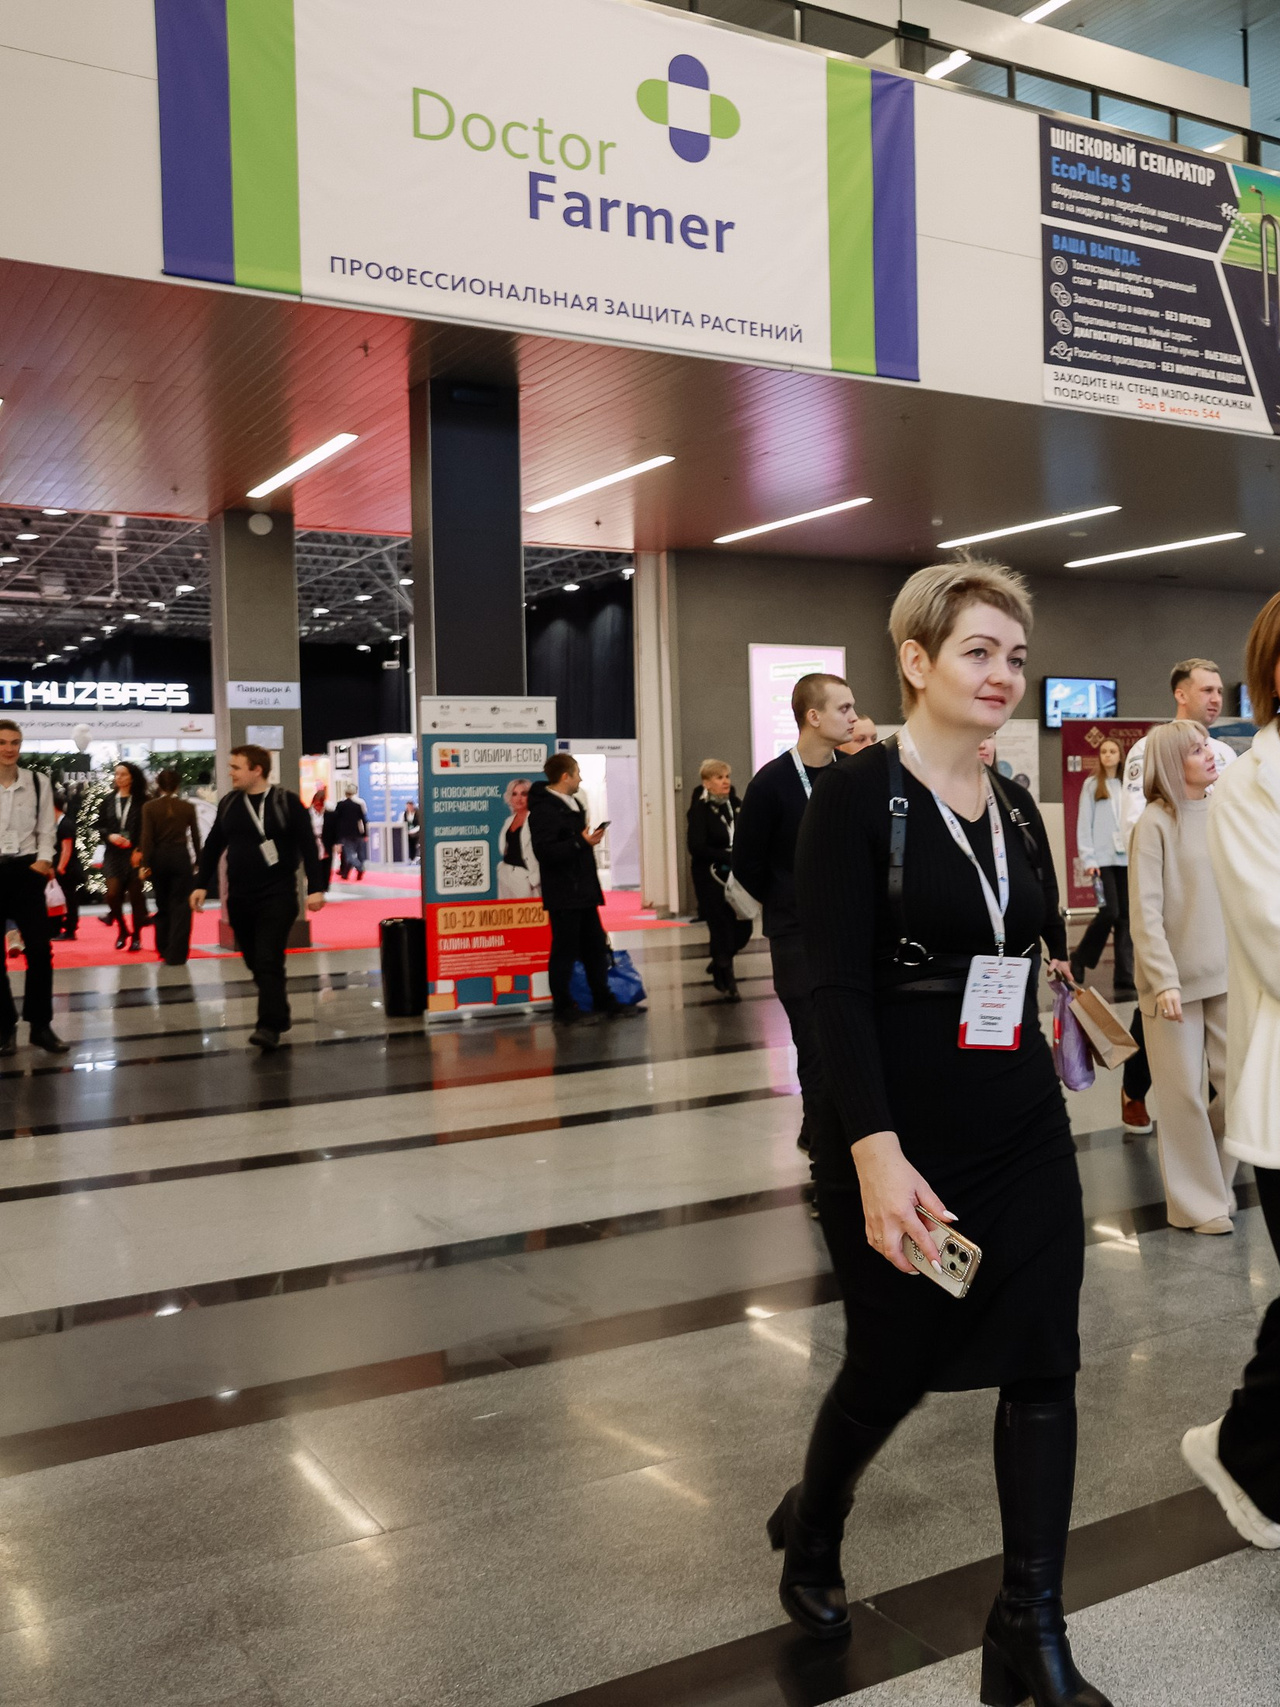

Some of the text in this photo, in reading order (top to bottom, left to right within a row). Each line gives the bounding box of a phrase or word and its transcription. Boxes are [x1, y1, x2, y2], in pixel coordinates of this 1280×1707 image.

[412, 87, 617, 175] Doctor
[1050, 127, 1216, 187] ШНЕКОВЫЙ СЕПАРАТОР
[1051, 156, 1131, 193] EcoPulse S
[528, 171, 735, 253] Farmer
[1052, 234, 1141, 267] ВАША ВЫГОДА:
[329, 255, 803, 344] ПРОФЕССИОНАЛЬНАЯ ЗАЩИТА РАСТЕНИЙ
[1053, 371, 1107, 389] ЗАХОДИТЕ
[1110, 380, 1125, 391] НА
[1127, 383, 1159, 398] СТЕНД
[1053, 387, 1119, 405] ПОДРОБНЕЕ!
[1137, 398, 1157, 412] Зал
[1169, 406, 1199, 417] место
[1202, 408, 1221, 420] 544
[23, 681, 189, 707] KUZBASS
[237, 684, 282, 693] Павильон
[463, 748, 542, 763] В СИБИРИ-ЕСТЬ!
[433, 787, 439, 799] В
[443, 910, 475, 930] 10-12
[480, 908, 514, 926] ИЮЛЯ
